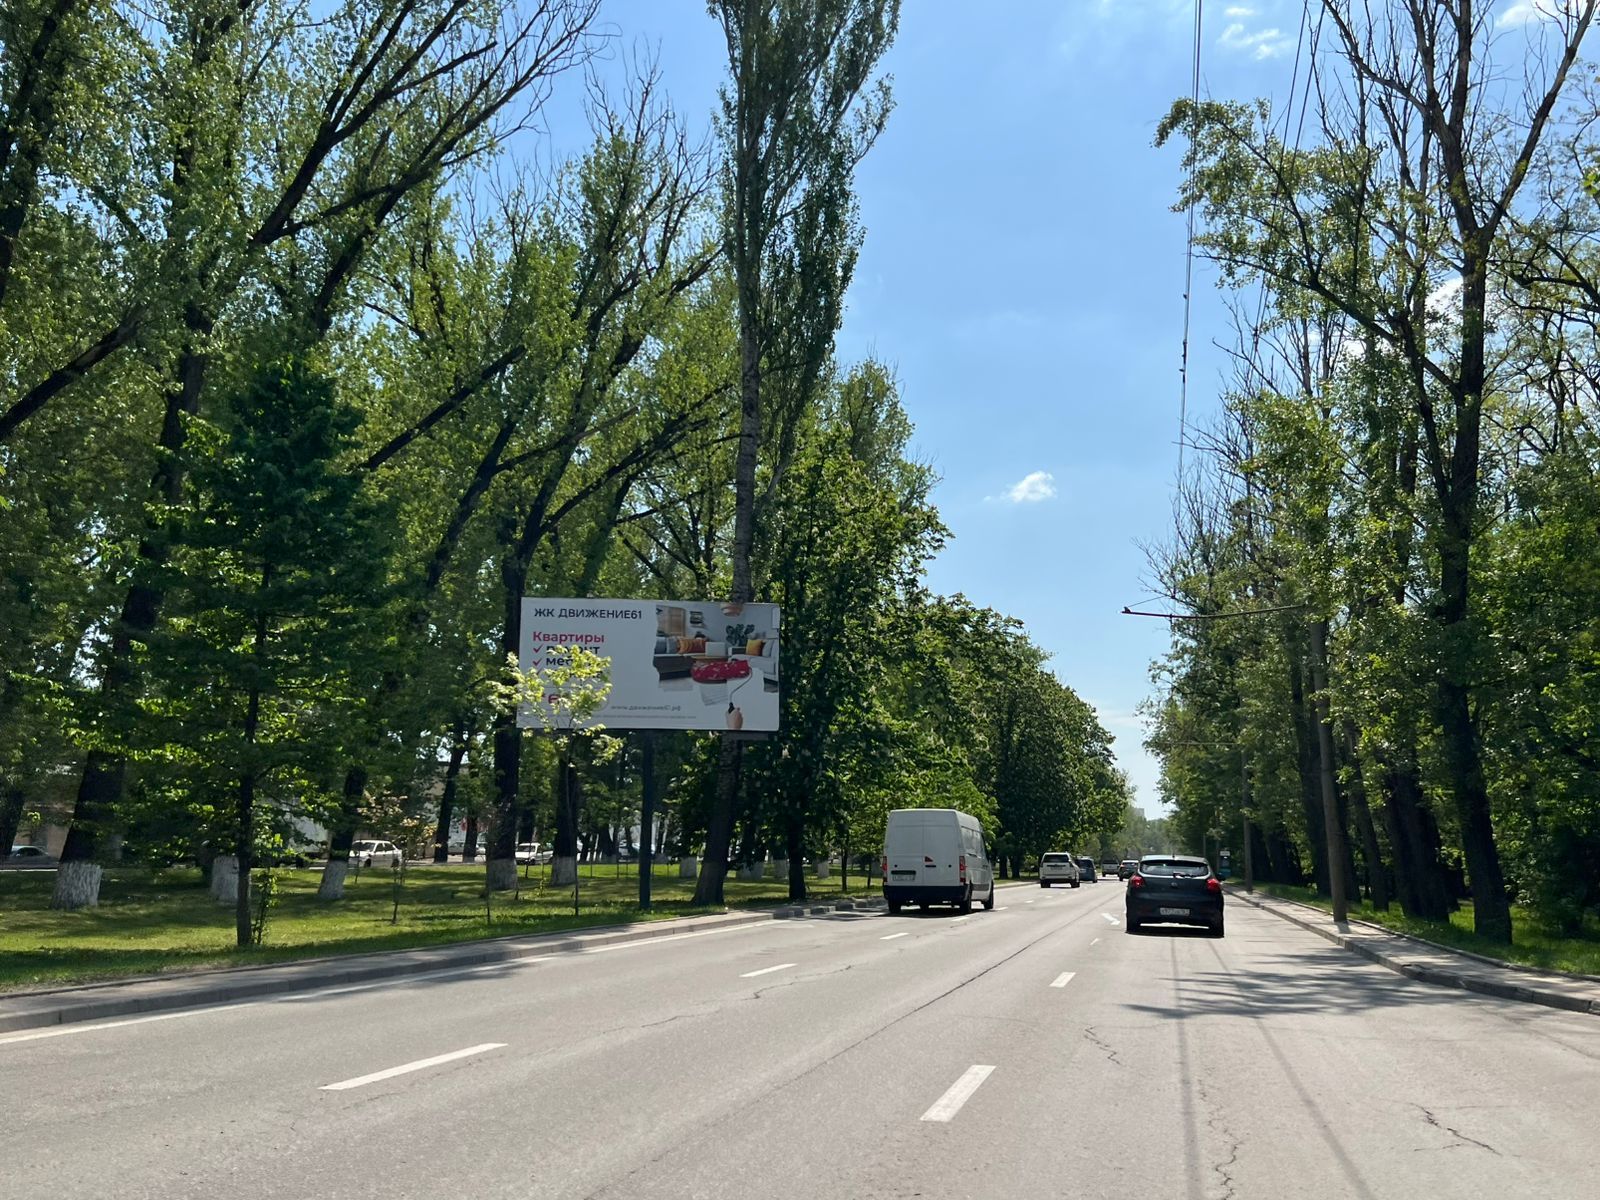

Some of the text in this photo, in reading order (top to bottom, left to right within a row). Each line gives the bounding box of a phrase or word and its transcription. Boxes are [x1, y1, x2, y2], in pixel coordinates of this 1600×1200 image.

[534, 608, 642, 619] ЖК ДВИЖЕНИЕ61
[533, 631, 605, 644] Квартиры
